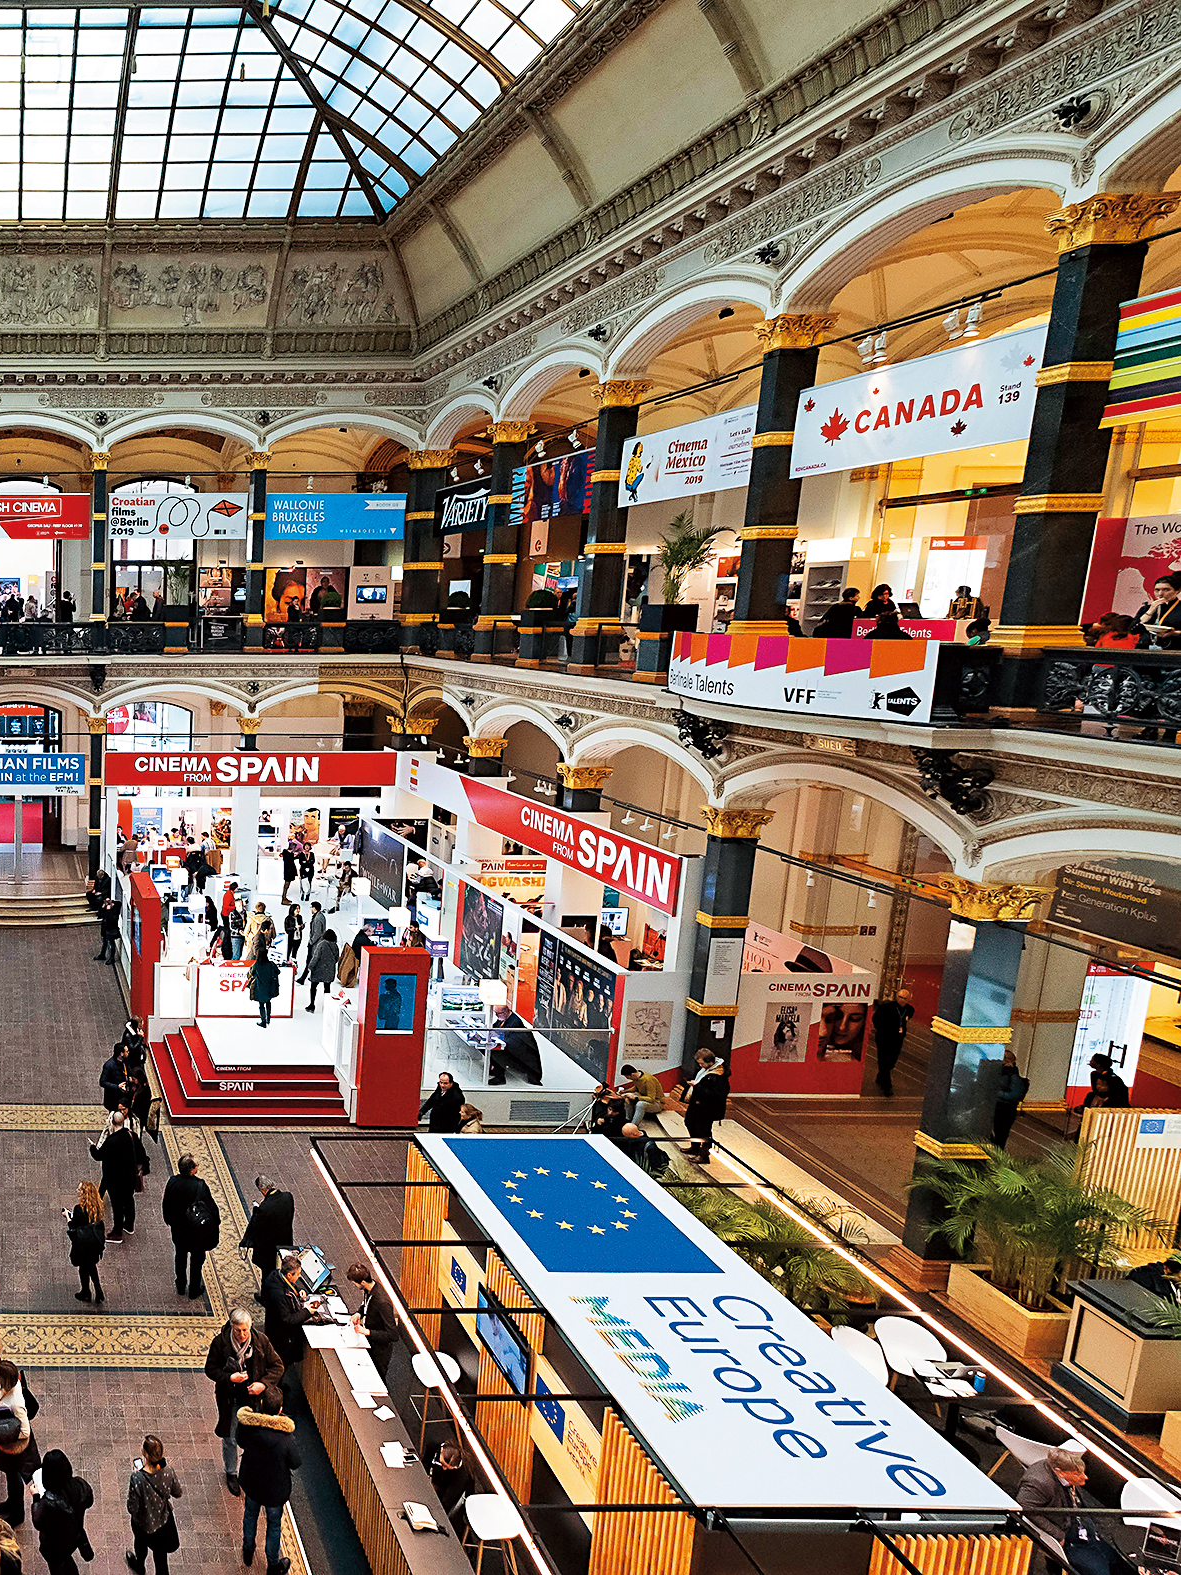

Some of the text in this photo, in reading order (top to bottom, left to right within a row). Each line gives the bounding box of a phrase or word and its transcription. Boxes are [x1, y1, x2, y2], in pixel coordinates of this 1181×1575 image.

[1000, 381, 1023, 393] Stand
[998, 390, 1021, 405] 139
[854, 383, 984, 435] CANADA
[668, 439, 708, 454] Cinema
[666, 452, 707, 470] México
[684, 475, 703, 485] 2019
[12, 502, 57, 513] CINEMA
[111, 497, 156, 506] Croatian
[273, 500, 325, 510] WALLONIE
[440, 488, 491, 530] VARIETY
[111, 507, 136, 516] films
[272, 512, 325, 521] BRUXELLES
[110, 517, 149, 527] @Berlin
[278, 524, 318, 534] IMAGES
[110, 527, 134, 535] 2019
[1134, 524, 1158, 536] The
[695, 673, 734, 696] Talents
[783, 687, 817, 704] VFF
[32, 757, 80, 770] FILMS
[134, 756, 212, 772] CINEMA
[215, 756, 320, 783] SPAIN
[15, 774, 26, 782] at
[29, 773, 47, 782] the
[183, 773, 212, 782] FROM
[520, 806, 575, 846] CINEMA
[552, 841, 574, 861] FROM
[576, 829, 672, 905] SPAIN
[1081, 861, 1156, 887] Extraordinary
[1064, 865, 1162, 896] Summer With Tess
[1075, 881, 1101, 892] Steven
[1102, 887, 1147, 905] Wouterlood
[1078, 893, 1128, 915] Generation
[1130, 908, 1157, 923] Kplus
[768, 983, 811, 991] CINEMA
[812, 983, 871, 998] SPAIN
[219, 1082, 254, 1091] SPAIN
[568, 1295, 707, 1424] MEDIA
[642, 1295, 828, 1459] Europe
[712, 1295, 947, 1498] Creative
[567, 1430, 592, 1473] Europe
[568, 1420, 598, 1469] Creative
